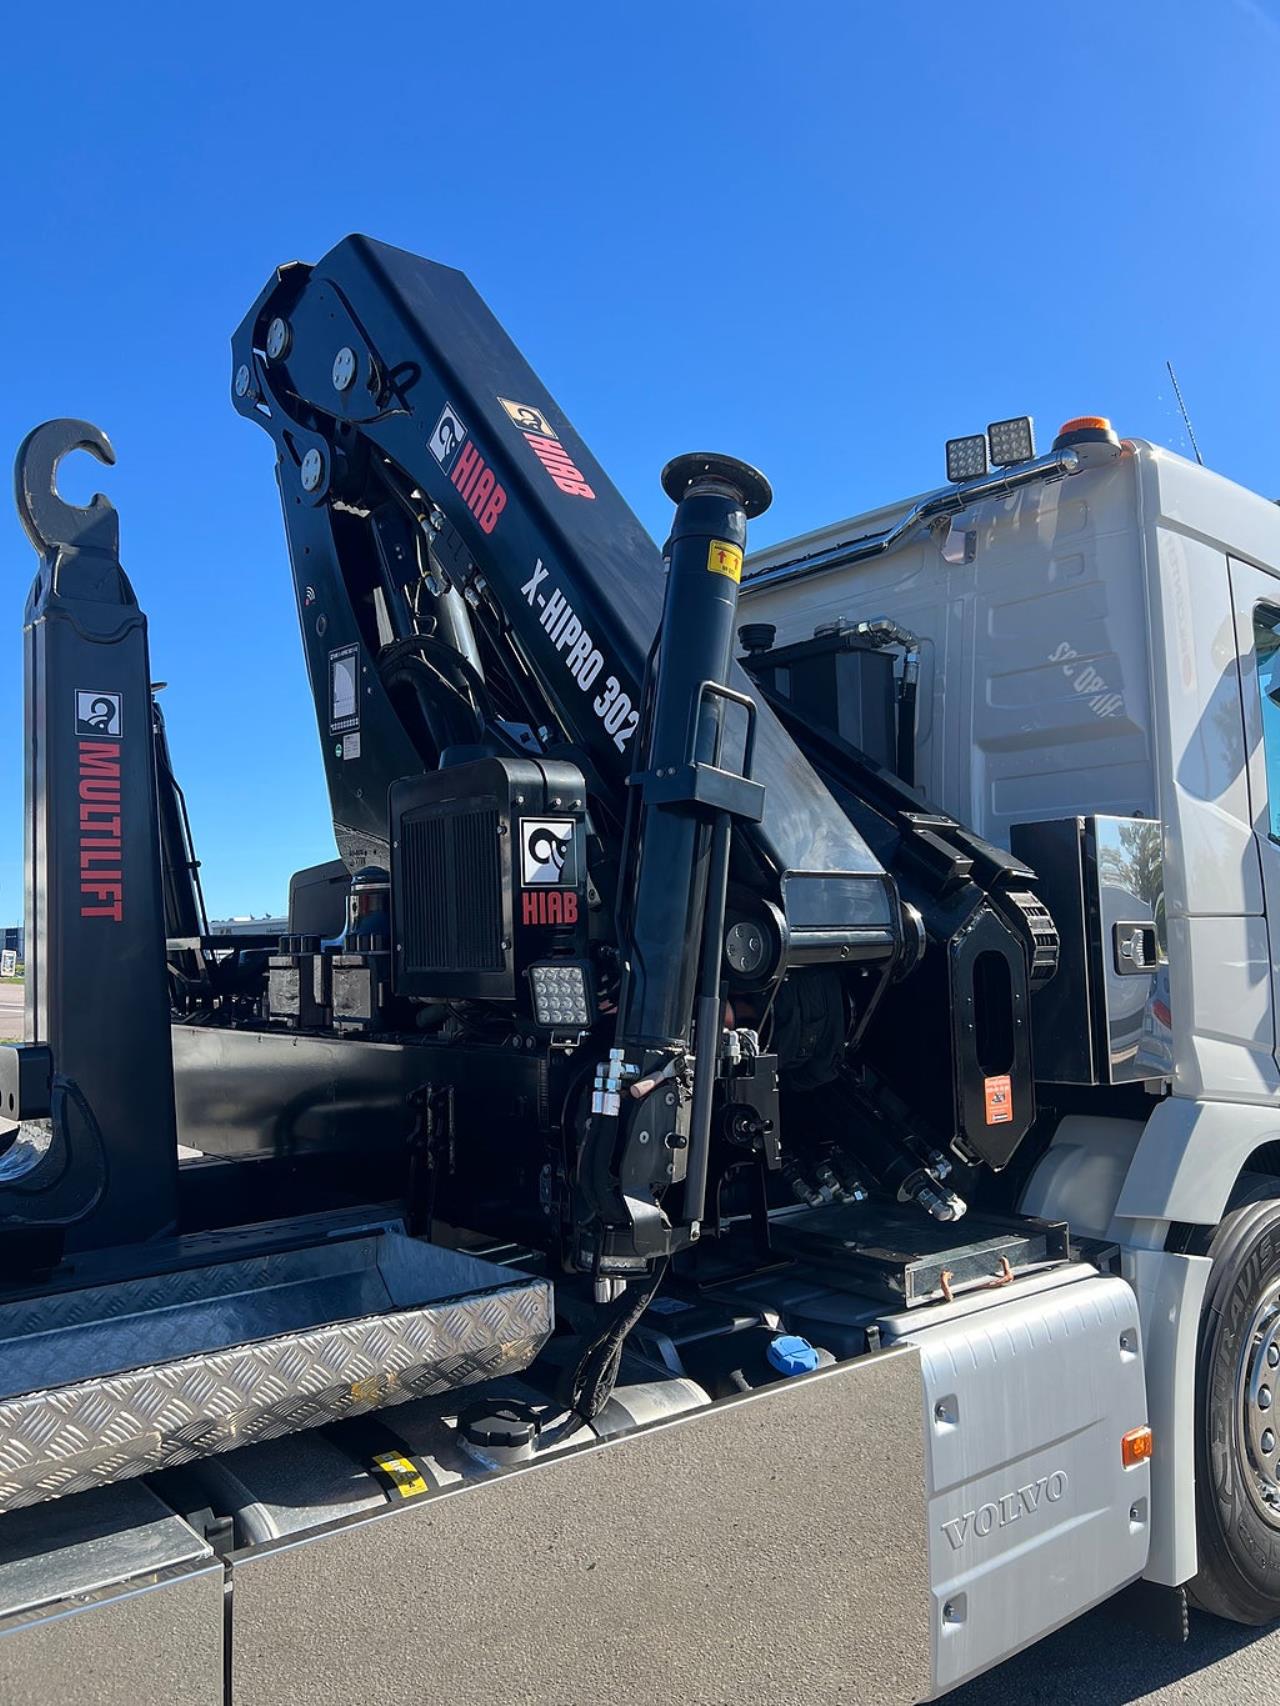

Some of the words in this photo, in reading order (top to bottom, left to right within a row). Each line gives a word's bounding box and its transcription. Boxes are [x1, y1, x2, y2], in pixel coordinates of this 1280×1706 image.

[450, 440, 507, 534] HIAB
[528, 435, 596, 499] HIAB
[520, 558, 604, 692] X-HIPRO
[593, 675, 640, 754] 302
[78, 741, 123, 921] MULTILIFT
[522, 891, 578, 925] HIAB
[940, 1469, 1069, 1551] VOLVO
